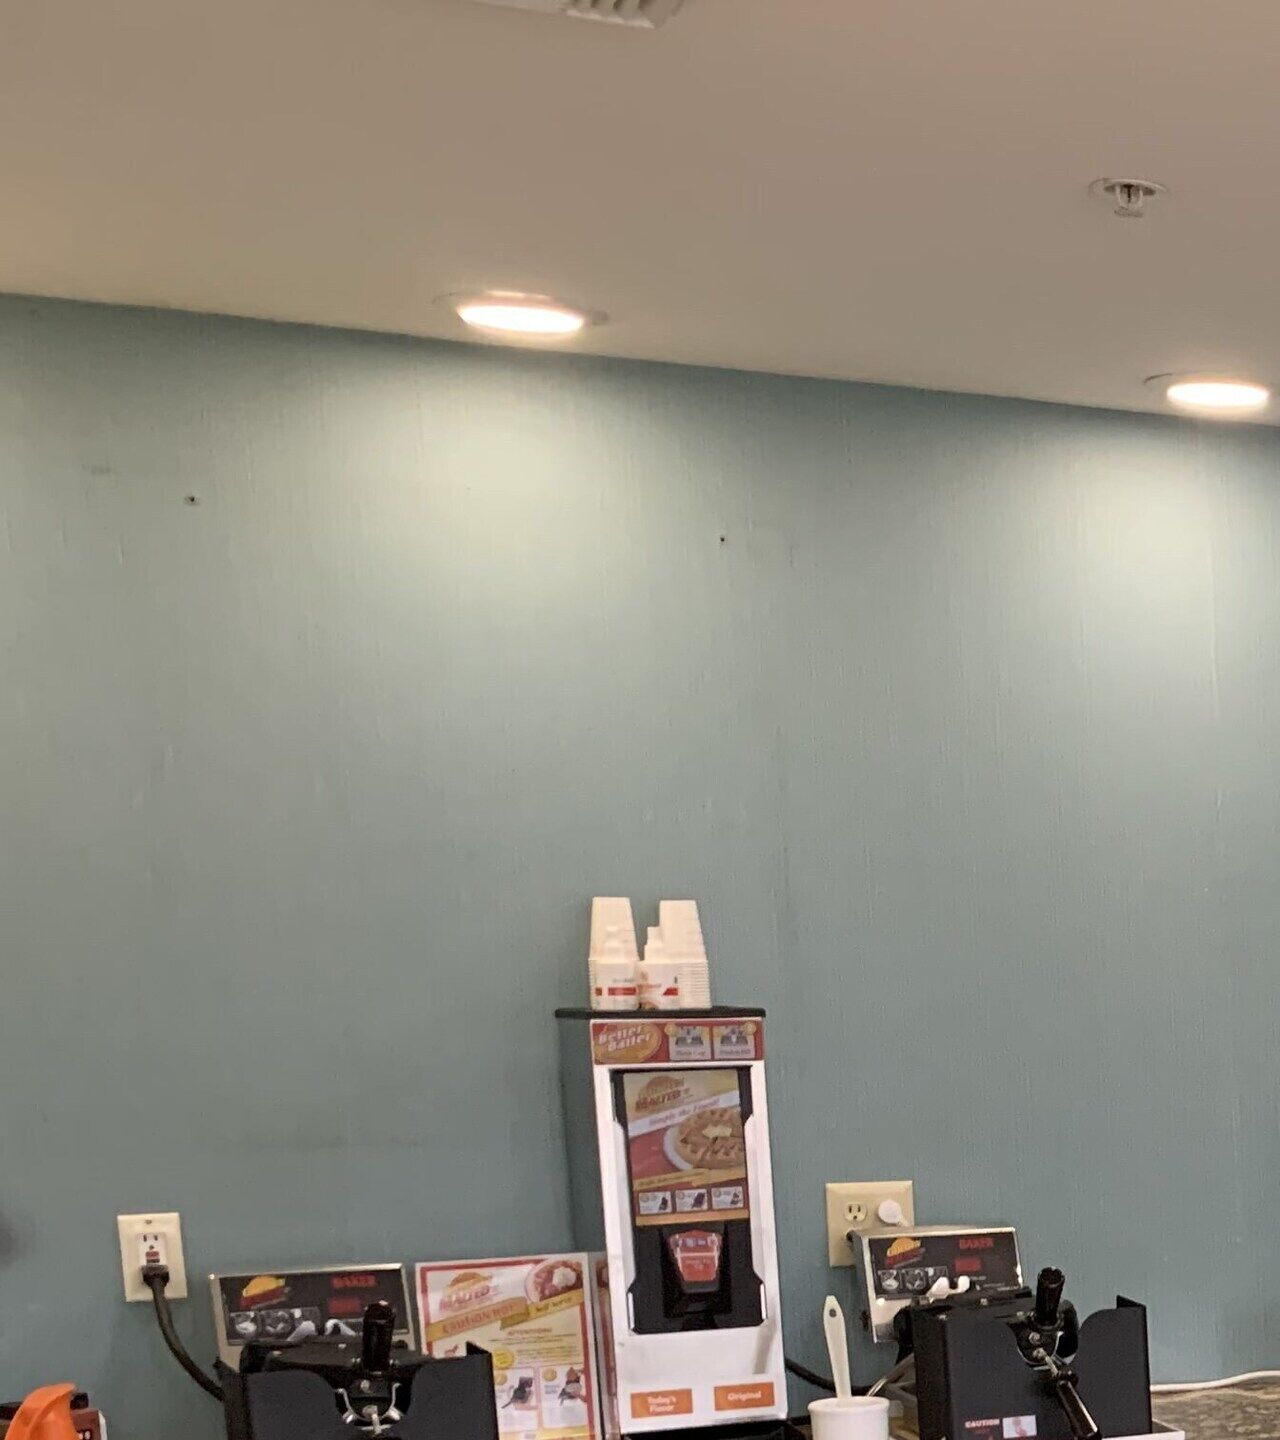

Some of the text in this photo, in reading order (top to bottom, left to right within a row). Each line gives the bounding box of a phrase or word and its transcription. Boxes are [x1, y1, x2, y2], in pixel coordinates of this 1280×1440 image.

[648, 1395, 676, 1405] Today's
[727, 1390, 762, 1402] Original
[650, 1405, 674, 1413] Flavor
[965, 1418, 1000, 1428] CAUTION
